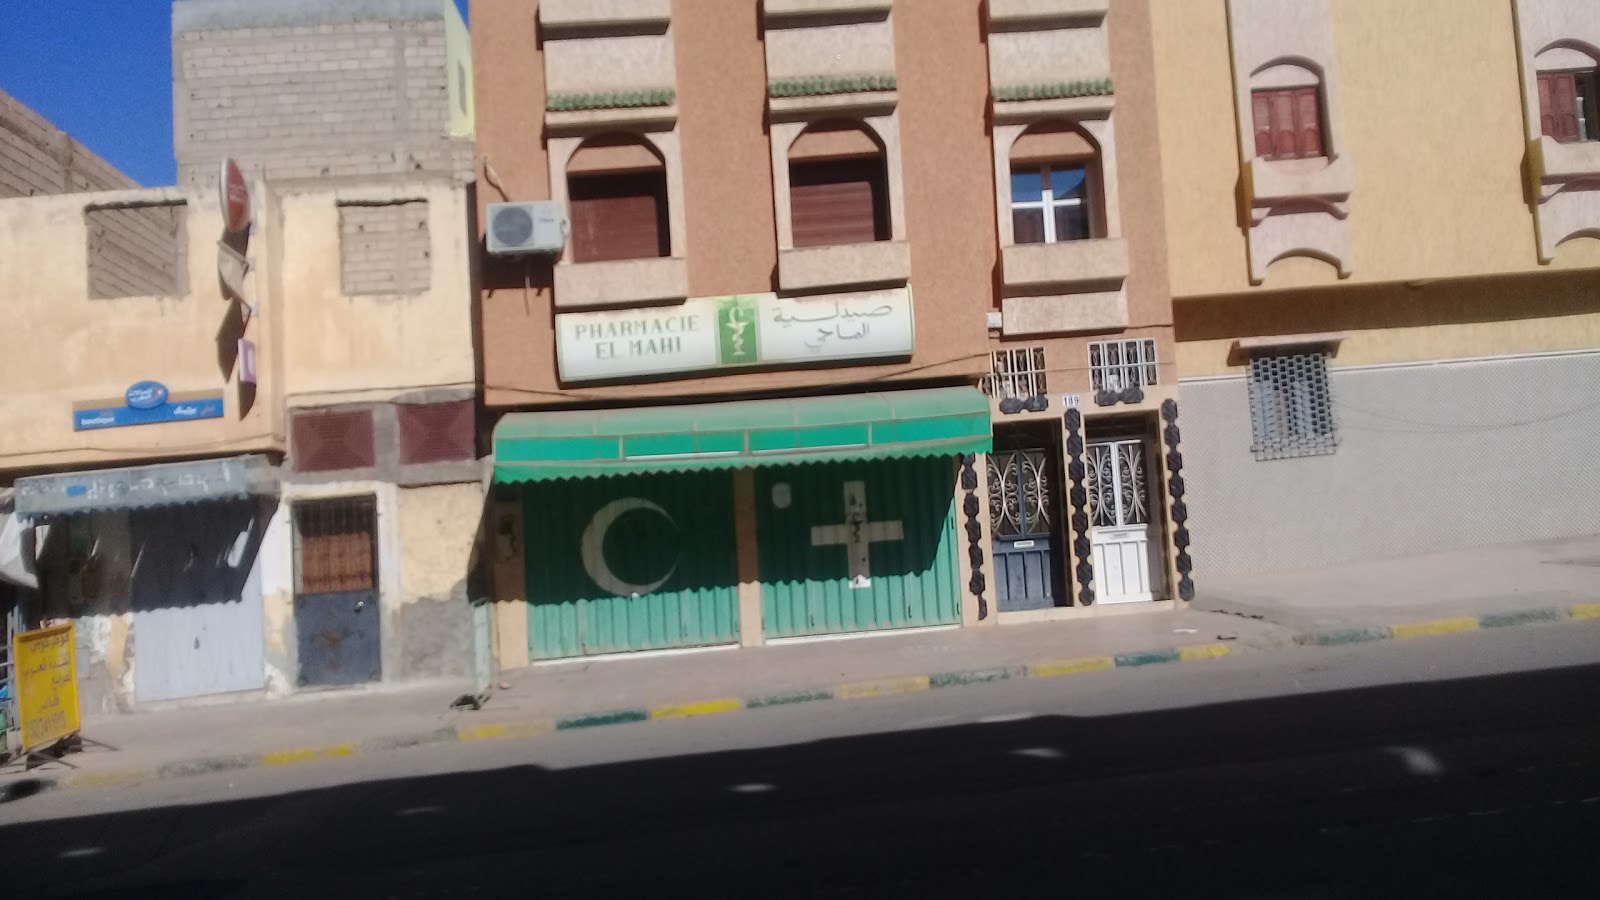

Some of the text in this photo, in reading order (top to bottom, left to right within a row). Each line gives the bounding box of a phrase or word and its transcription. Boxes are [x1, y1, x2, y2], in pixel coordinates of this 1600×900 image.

[574, 314, 701, 340] PHARMACIE
[595, 336, 682, 360] EL MAHI
